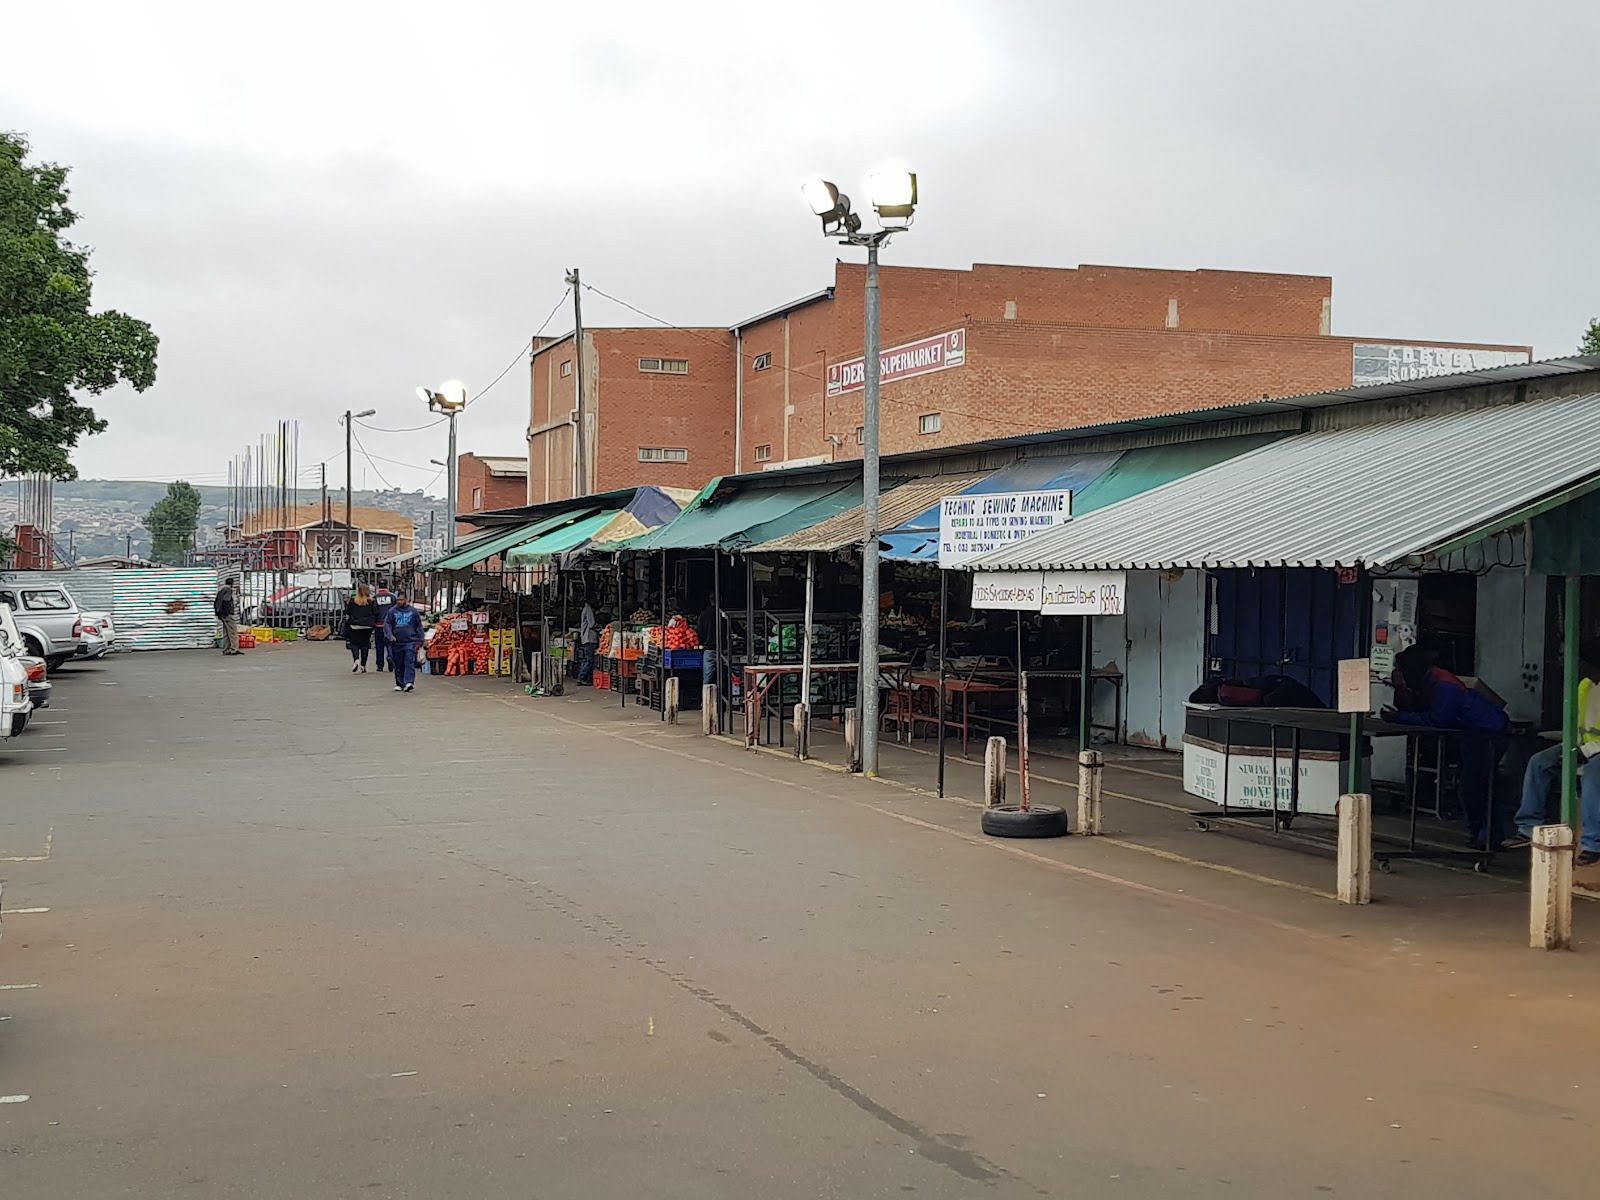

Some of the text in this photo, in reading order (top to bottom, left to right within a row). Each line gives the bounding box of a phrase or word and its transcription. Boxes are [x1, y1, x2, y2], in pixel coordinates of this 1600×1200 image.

[880, 343, 943, 376] SUPERMARKET
[944, 494, 1064, 516] TECHNIC SEWING MACHINE
[474, 612, 487, 622] 79
[1239, 764, 1269, 775] SEWING
